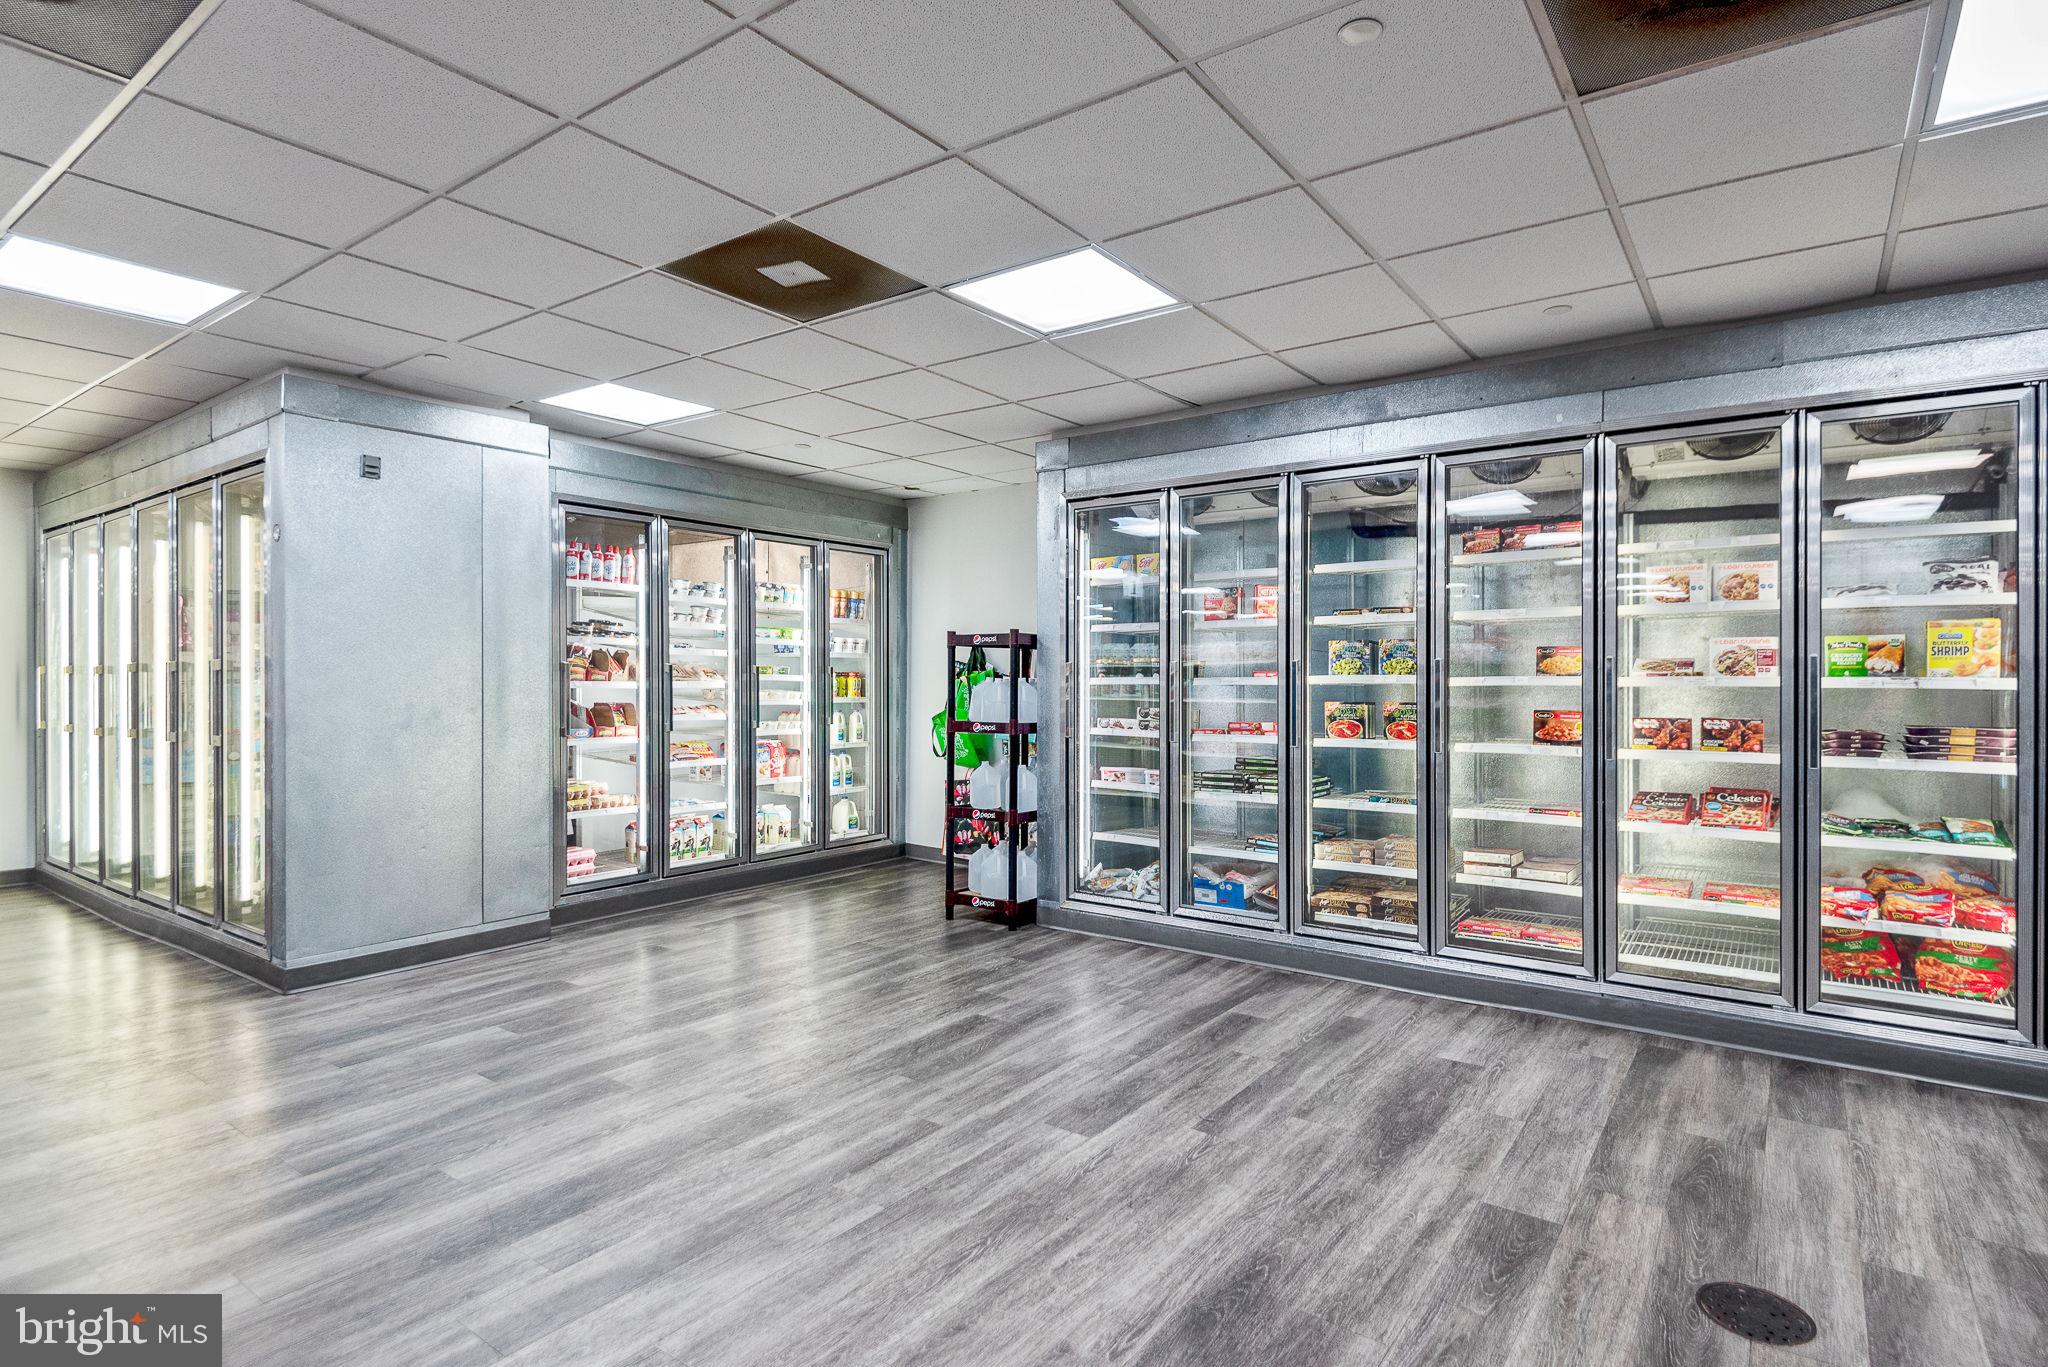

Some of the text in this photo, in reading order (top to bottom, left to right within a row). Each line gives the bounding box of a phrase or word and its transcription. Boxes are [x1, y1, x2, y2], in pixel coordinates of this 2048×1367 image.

[1931, 646, 1970, 656] SHRIMP
[1716, 792, 1762, 803] Celeste
[1643, 799, 1685, 807] Celeste
